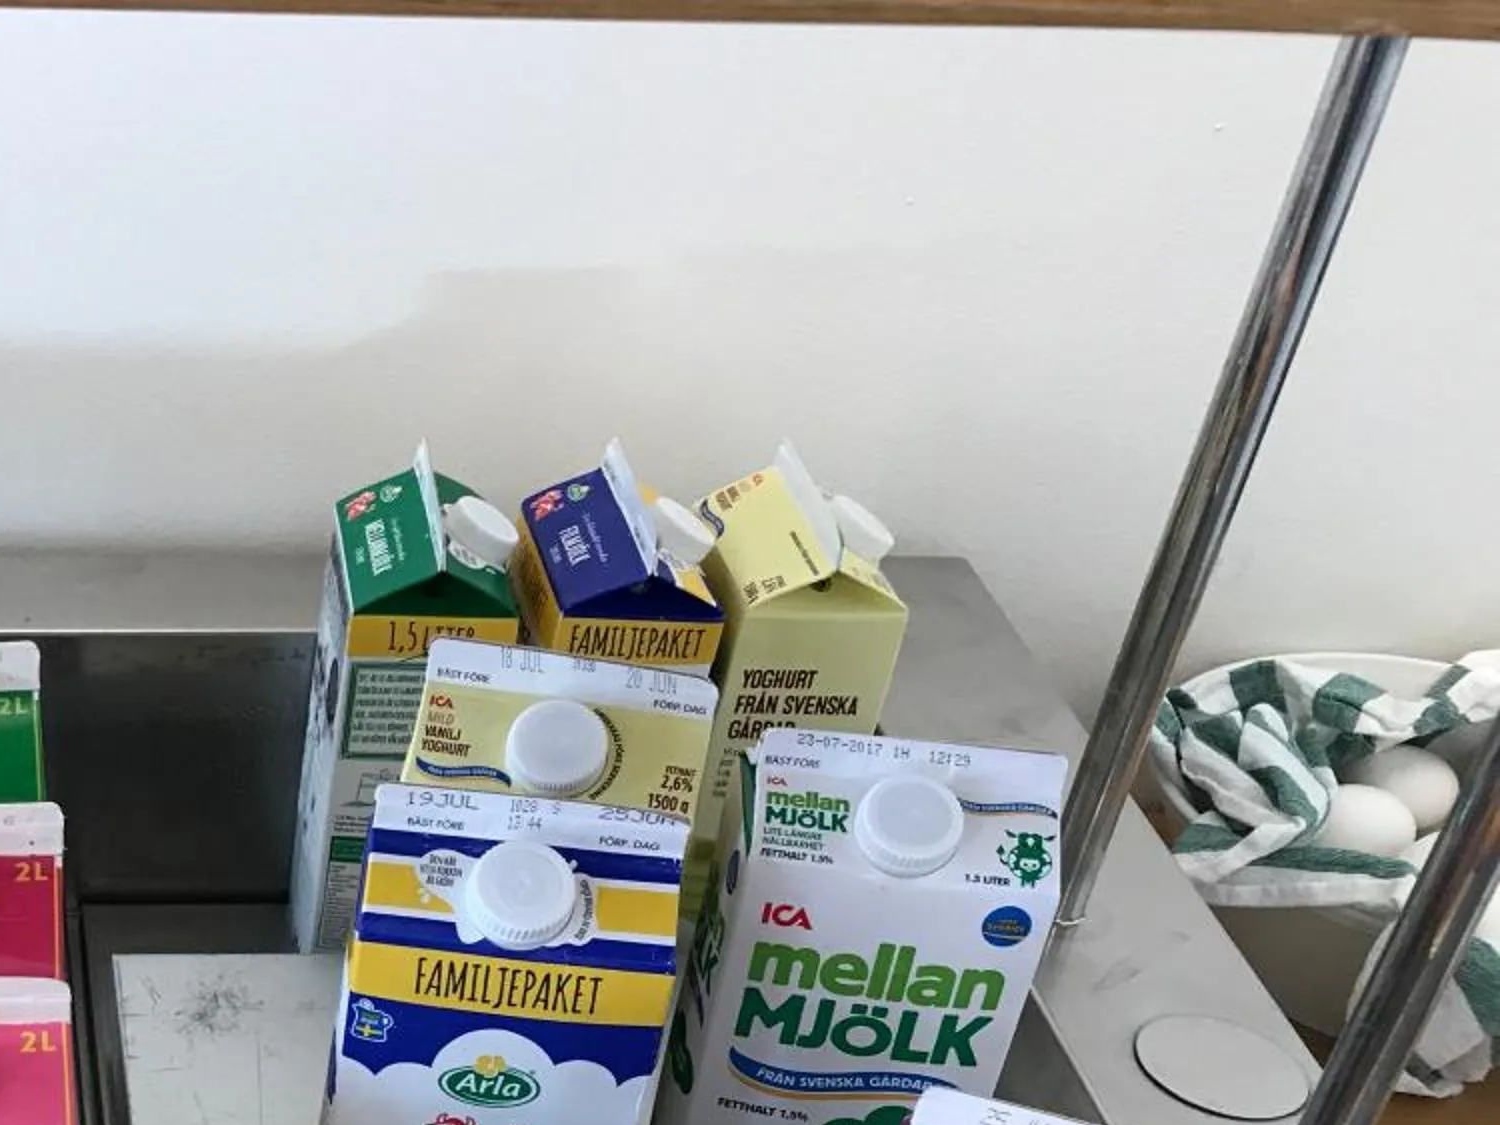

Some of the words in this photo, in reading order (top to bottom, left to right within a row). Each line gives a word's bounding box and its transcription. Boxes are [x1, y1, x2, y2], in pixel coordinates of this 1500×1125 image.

[569, 623, 708, 660] FAMILJEPAKET
[741, 669, 818, 690] YOGHURT
[429, 694, 454, 709] ICA
[732, 692, 779, 715] FRÅN
[782, 695, 859, 716] SVENSKA
[422, 738, 471, 759] YOGHURT
[797, 733, 883, 758] 23-07-2017
[661, 776, 694, 793] 2,6%
[648, 793, 678, 811] 1500
[766, 791, 850, 813] mellan
[765, 805, 849, 834] MJÖLK
[761, 902, 812, 930] ICA
[414, 957, 604, 1016] FAMILJEPAKET
[747, 941, 1006, 1011] mellan
[734, 987, 994, 1067] MJÖLK
[454, 1075, 522, 1099] Arla
[756, 1065, 796, 1088] FRÅN
[799, 1073, 865, 1089] SVENSKA
